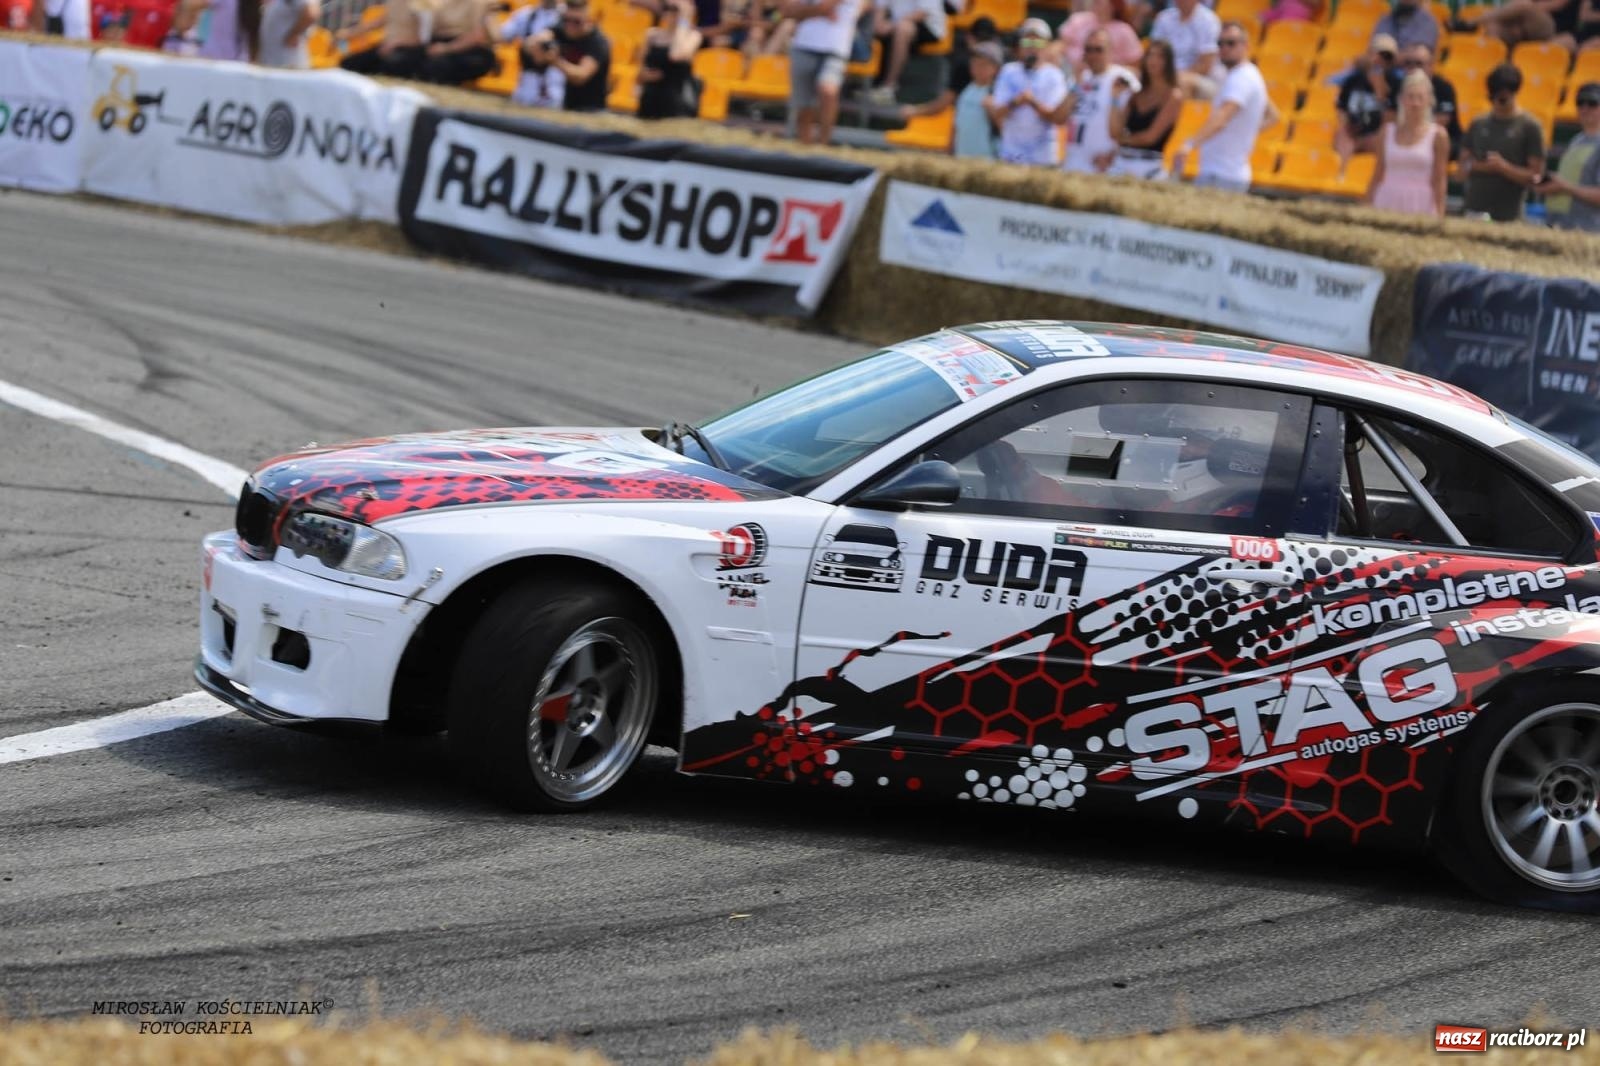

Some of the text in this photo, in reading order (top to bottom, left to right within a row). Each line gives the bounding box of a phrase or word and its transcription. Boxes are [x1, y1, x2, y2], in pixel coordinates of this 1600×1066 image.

[436, 143, 779, 259] RALLYSHOP
[919, 533, 1089, 598] DUDA
[1235, 537, 1274, 560] 006
[915, 580, 1080, 611] GAZ SERWIS
[1313, 565, 1567, 637] kompletne
[1123, 637, 1459, 780] STAG
[1301, 710, 1470, 760] autogas systems
